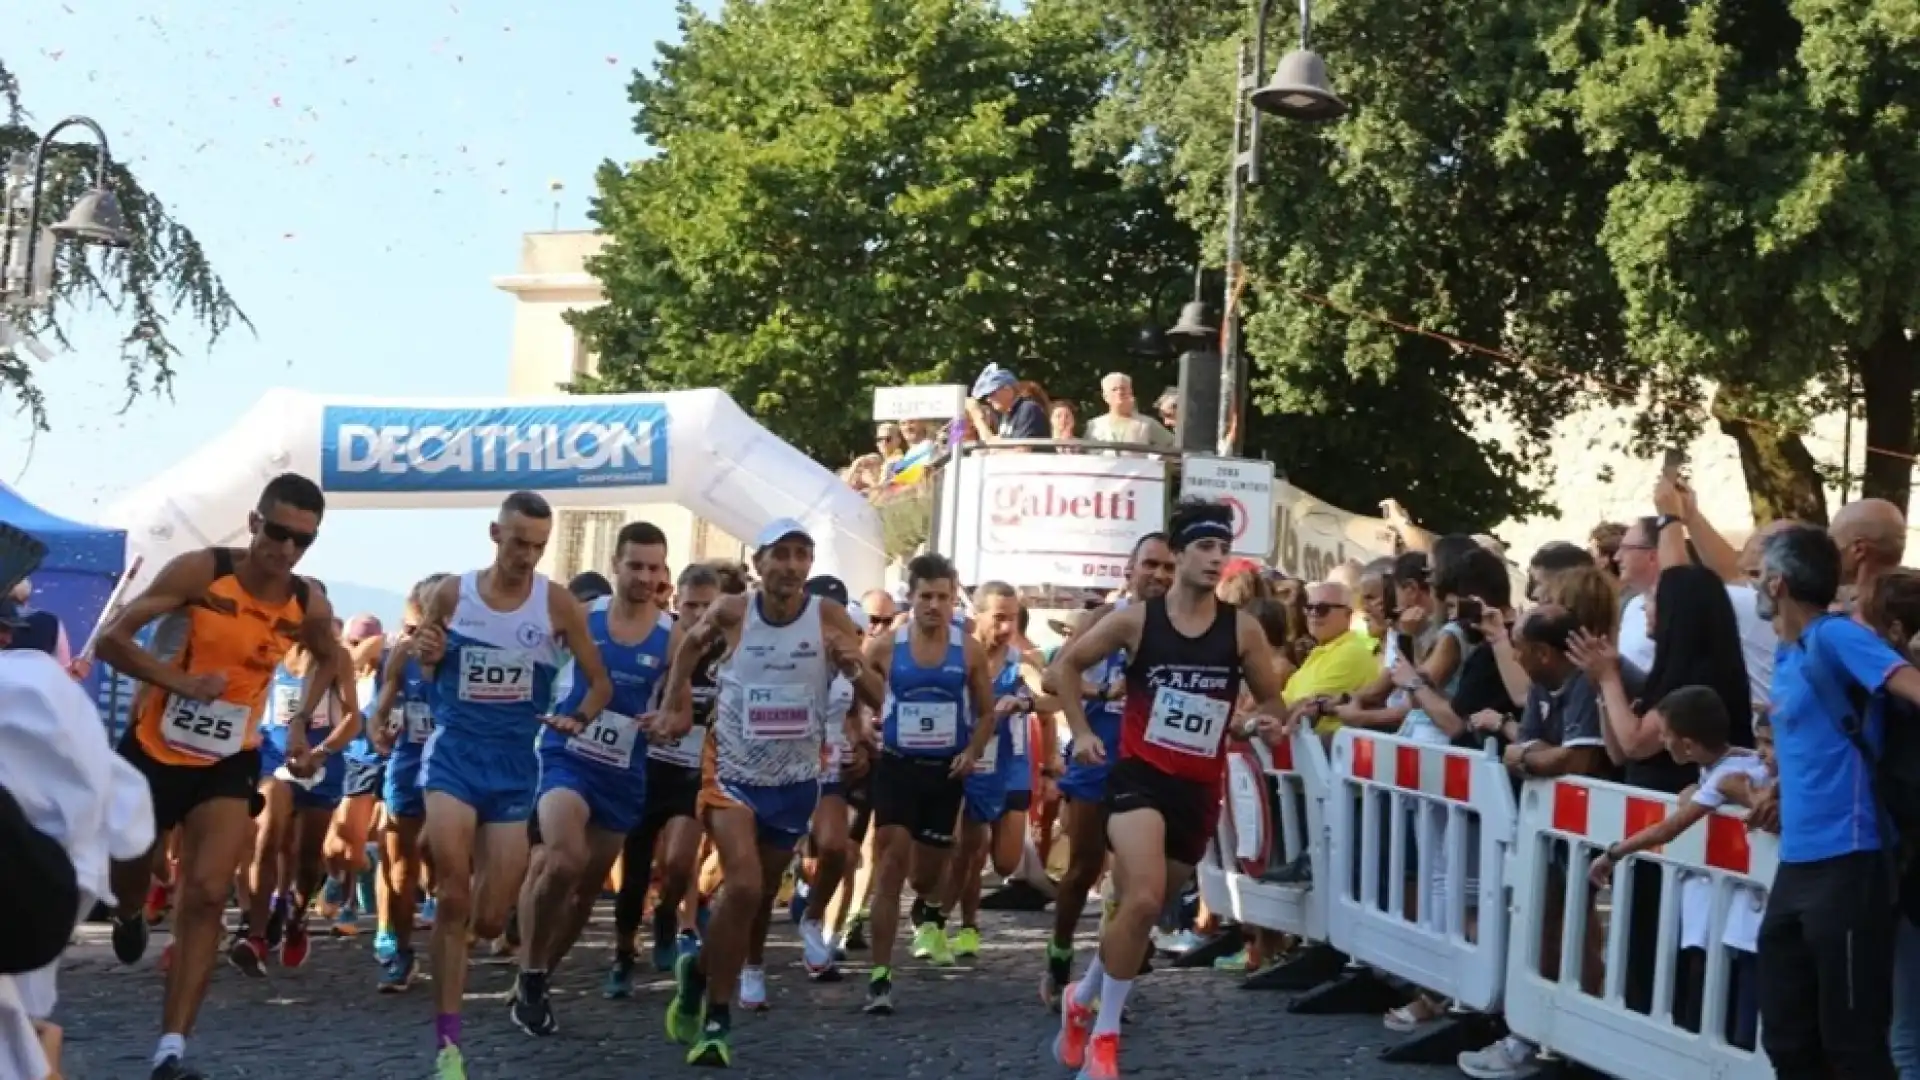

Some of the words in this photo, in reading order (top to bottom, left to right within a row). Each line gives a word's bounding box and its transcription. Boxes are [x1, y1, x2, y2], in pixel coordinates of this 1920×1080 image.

[337, 421, 652, 474] DECATHLON
[990, 484, 1137, 526] gabetti
[468, 665, 523, 685] 207
[172, 708, 233, 741] 225
[593, 725, 618, 746] 10
[919, 717, 934, 733] 9
[1163, 708, 1213, 736] 201
